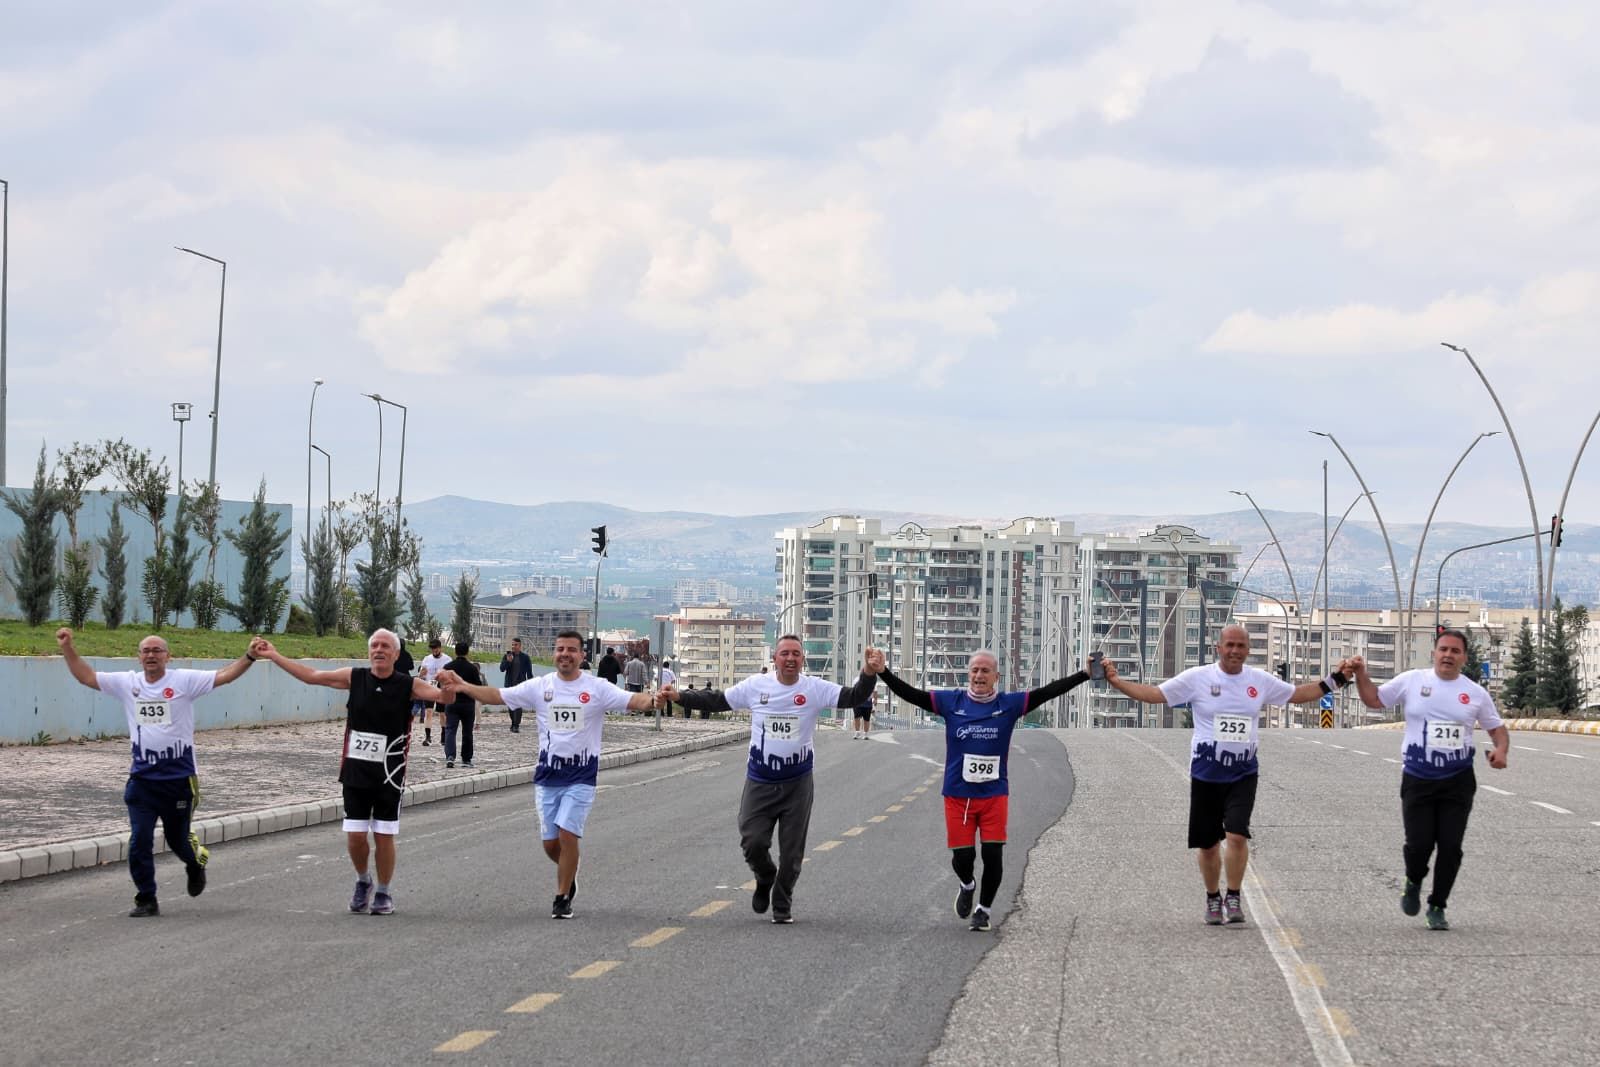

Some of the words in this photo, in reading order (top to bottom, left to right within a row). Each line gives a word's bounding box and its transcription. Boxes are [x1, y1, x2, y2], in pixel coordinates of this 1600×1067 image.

[140, 706, 165, 717] 433
[554, 711, 576, 722] 191
[772, 721, 791, 733] 045
[1220, 721, 1246, 734] 252
[1435, 727, 1459, 739] 214
[355, 739, 379, 752] 275
[969, 762, 994, 774] 398
